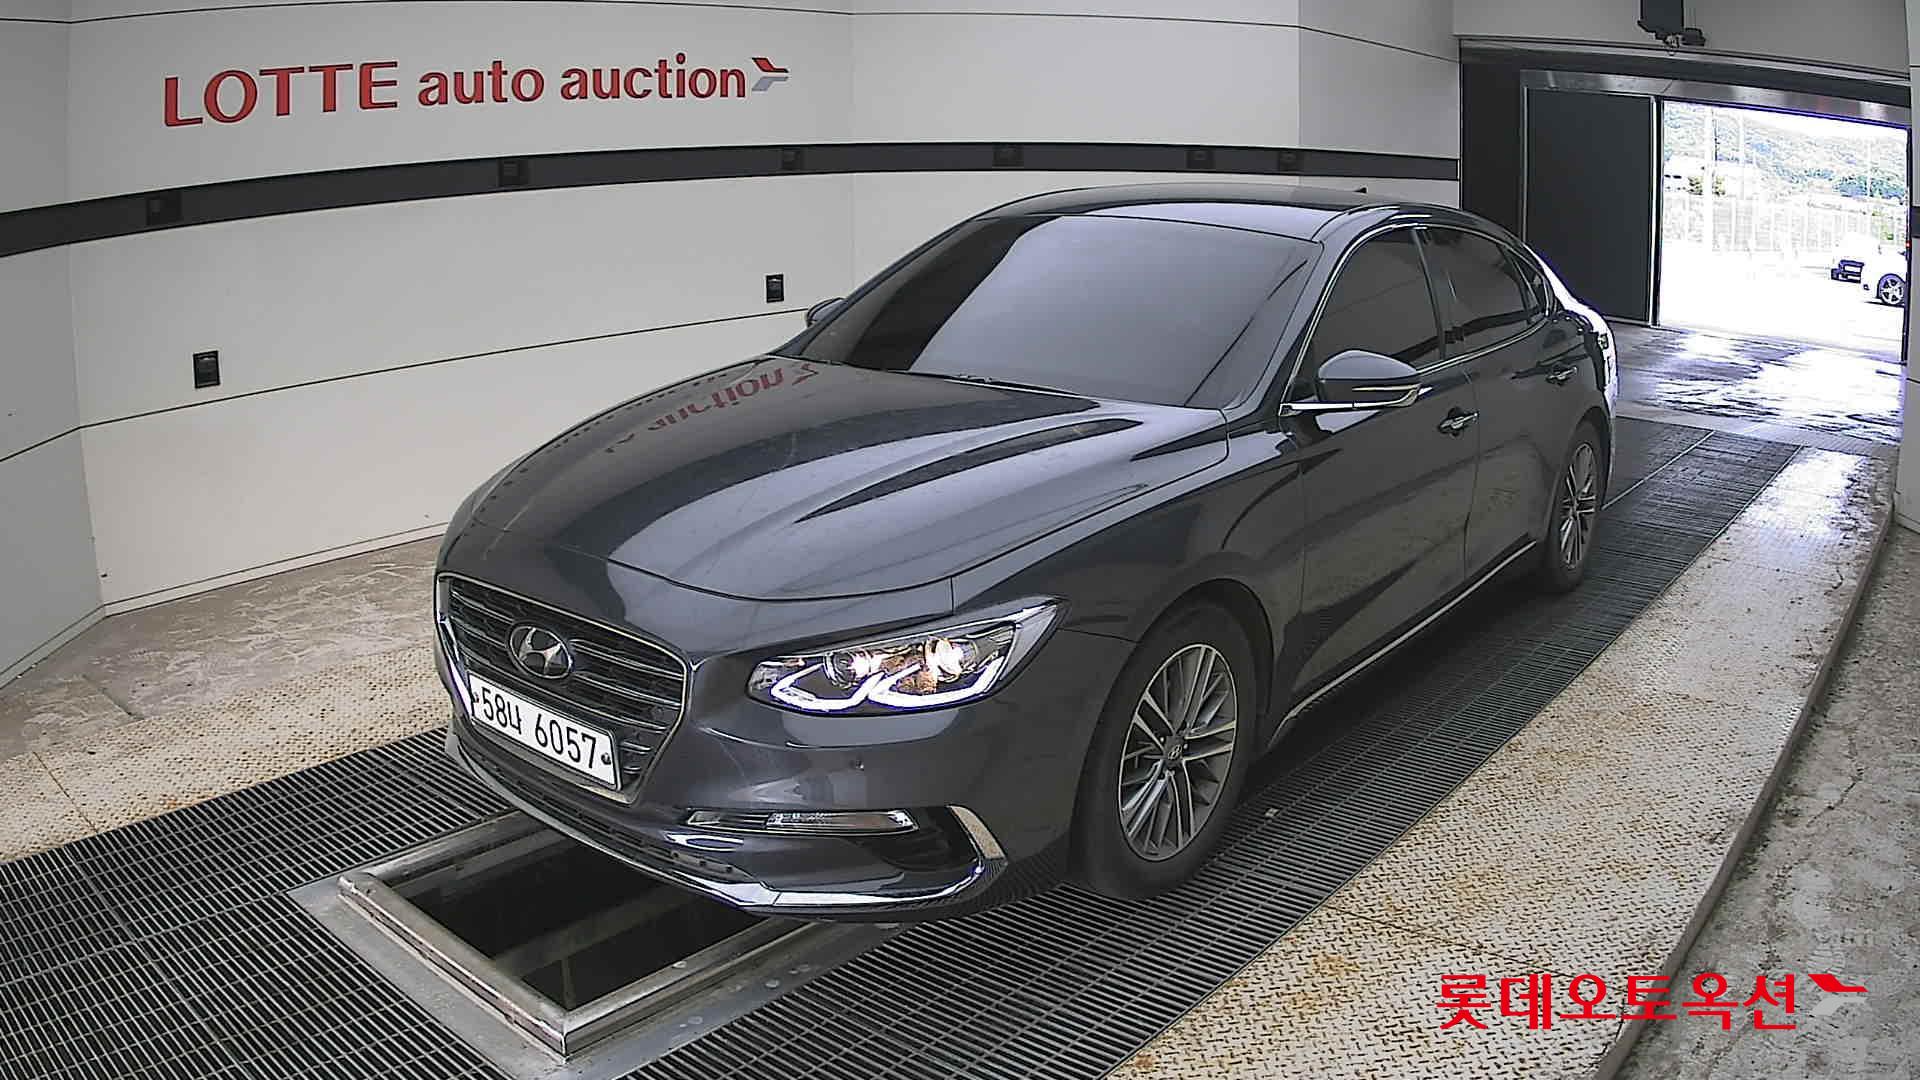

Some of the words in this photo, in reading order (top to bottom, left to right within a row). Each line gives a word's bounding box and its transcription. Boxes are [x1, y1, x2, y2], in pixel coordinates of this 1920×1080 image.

[164, 61, 398, 127] LOTTE
[418, 60, 545, 106] auto
[560, 52, 747, 100] auction
[481, 686, 522, 735] 58나
[535, 713, 597, 769] 6057
